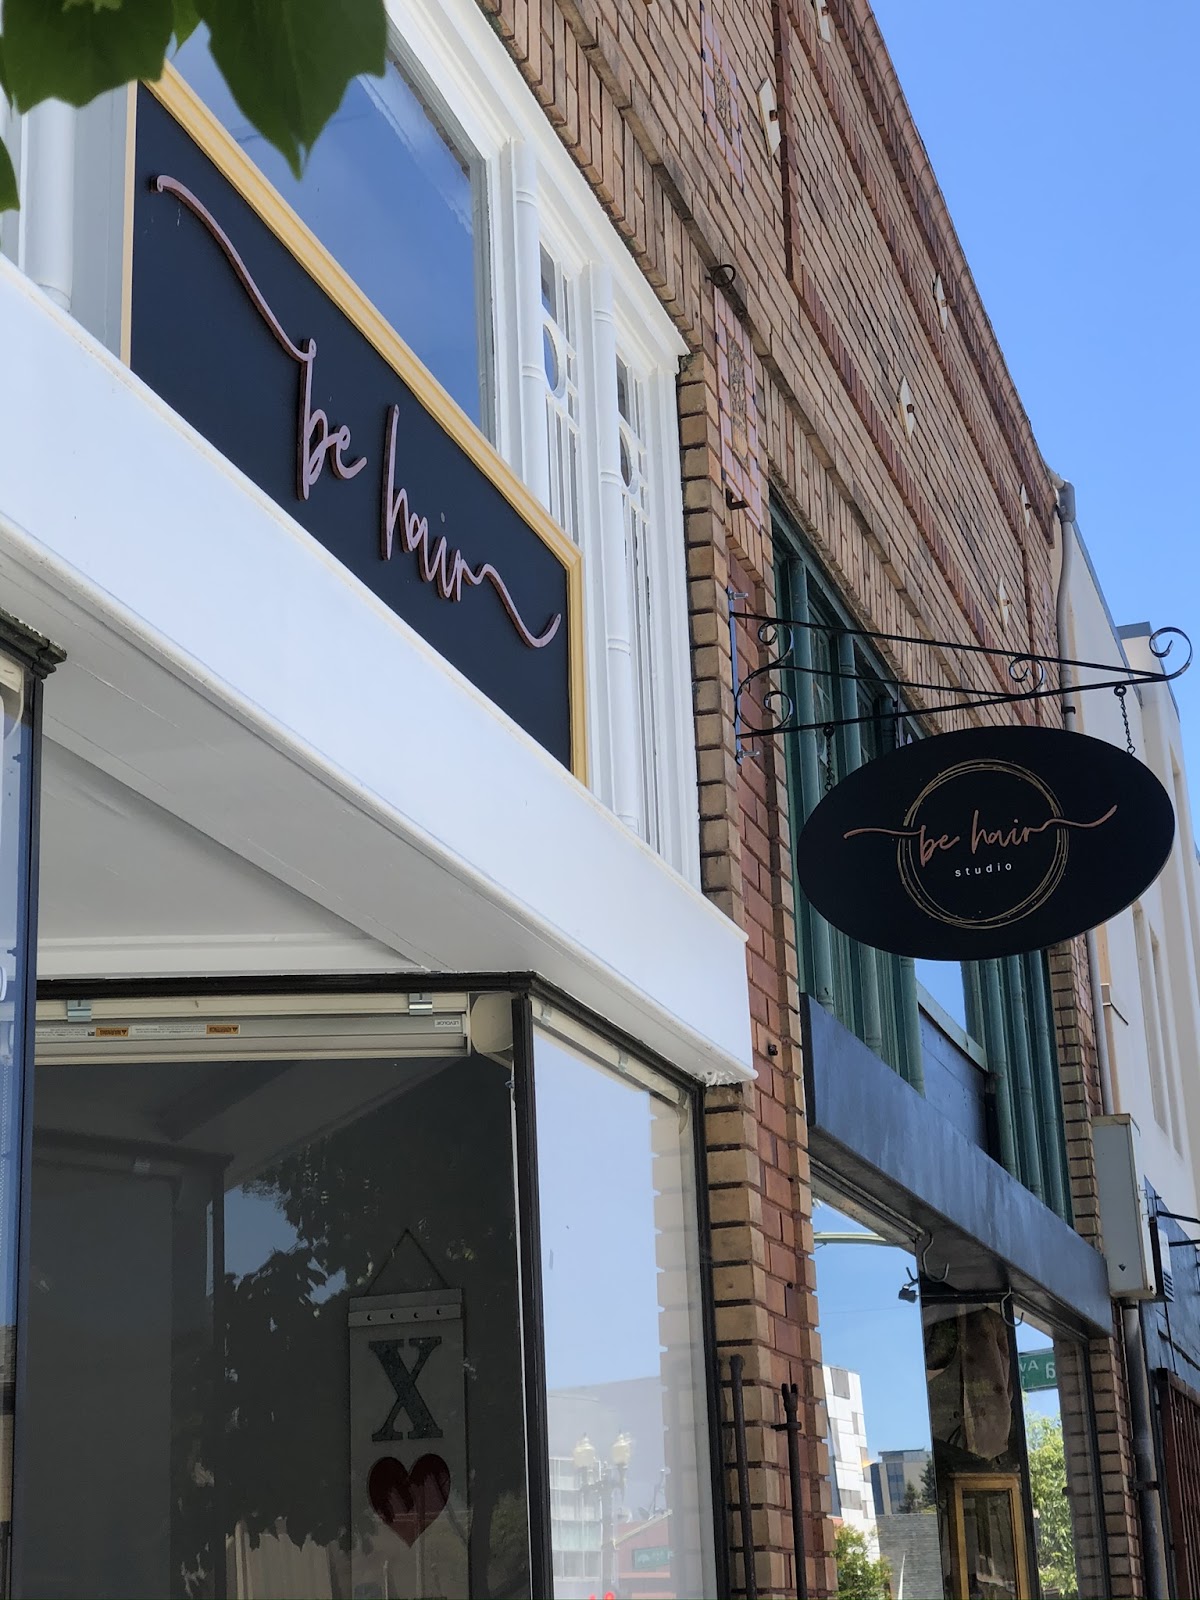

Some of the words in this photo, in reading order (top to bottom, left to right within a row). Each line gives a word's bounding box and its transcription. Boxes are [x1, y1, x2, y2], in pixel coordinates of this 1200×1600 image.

[382, 404, 500, 602] hair
[919, 824, 960, 868] be
[971, 809, 1054, 854] hair
[955, 862, 1012, 877] studio
[368, 1336, 444, 1442] X
